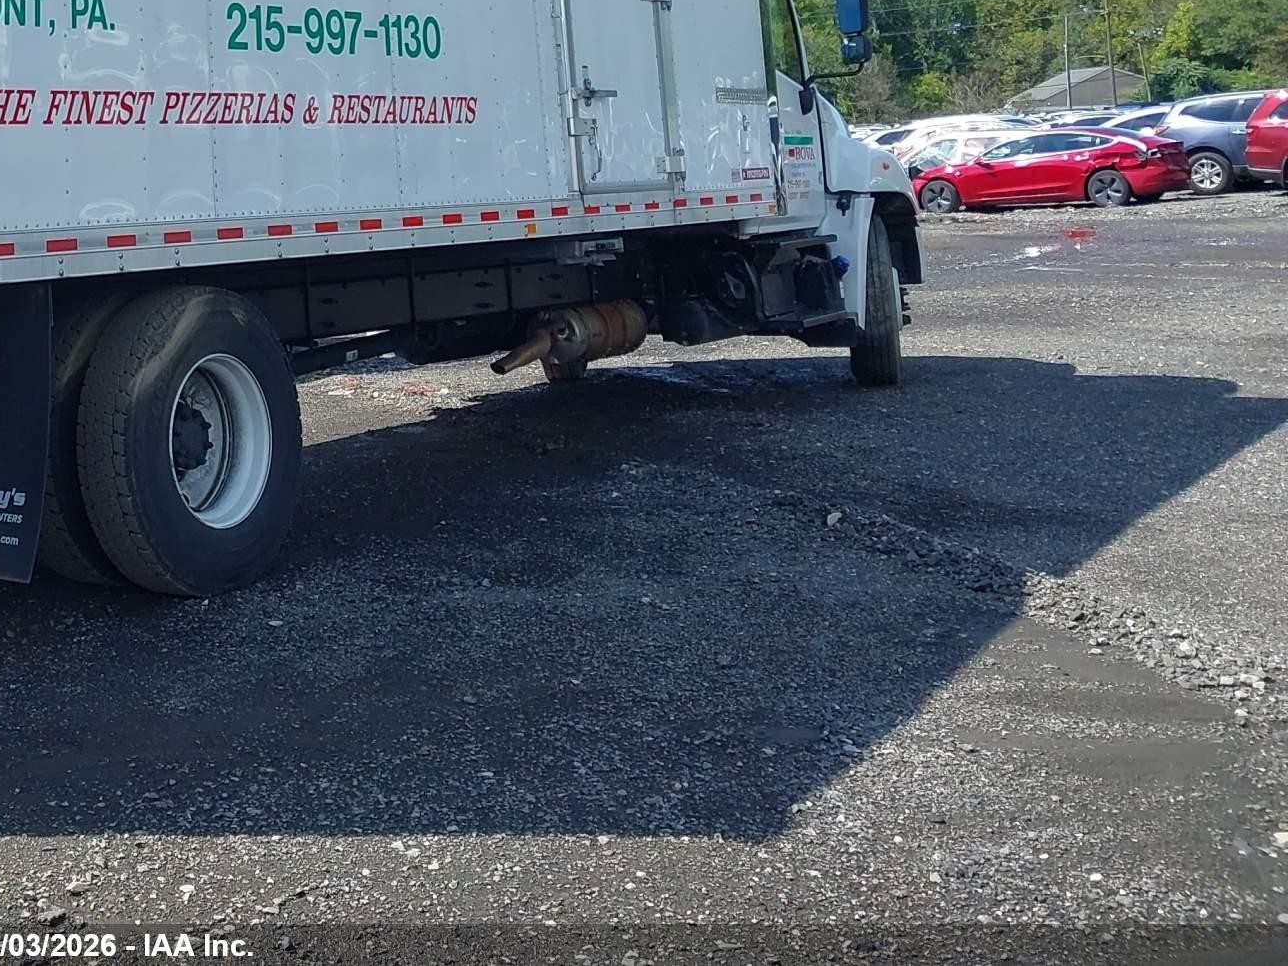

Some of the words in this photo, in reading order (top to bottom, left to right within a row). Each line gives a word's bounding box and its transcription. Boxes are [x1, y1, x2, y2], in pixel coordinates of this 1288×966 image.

[225, 2, 442, 59] 215-997-1130
[42, 89, 154, 125] FINEST
[160, 91, 296, 125] PIZZERIAS
[302, 96, 319, 125] &
[327, 95, 478, 125] RESTAURANTS
[795, 146, 816, 161] BOVA
